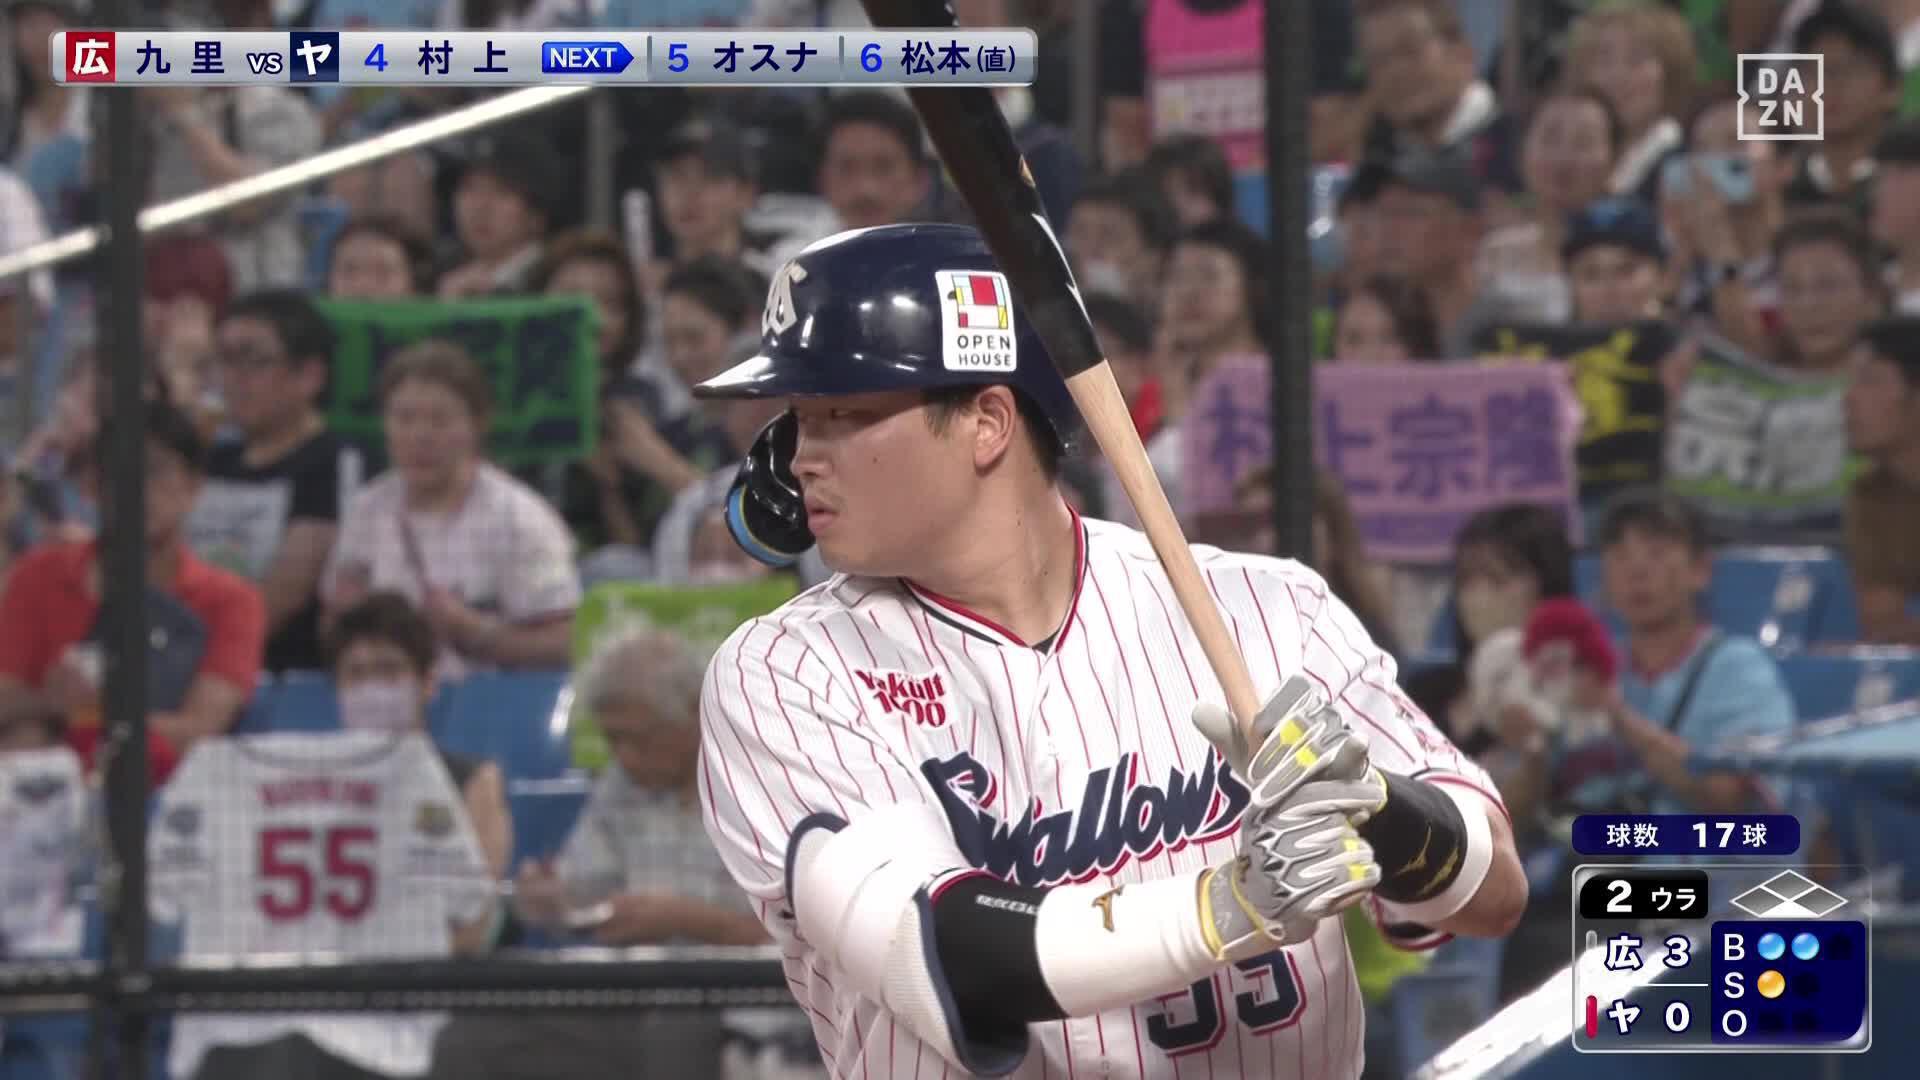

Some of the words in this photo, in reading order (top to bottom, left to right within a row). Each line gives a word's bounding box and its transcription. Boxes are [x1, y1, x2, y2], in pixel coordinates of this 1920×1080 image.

[957, 335, 1011, 350] OPEN
[958, 353, 1012, 367] HOUSE
[920, 744, 1252, 889] Swallows
[257, 827, 379, 923] 55
